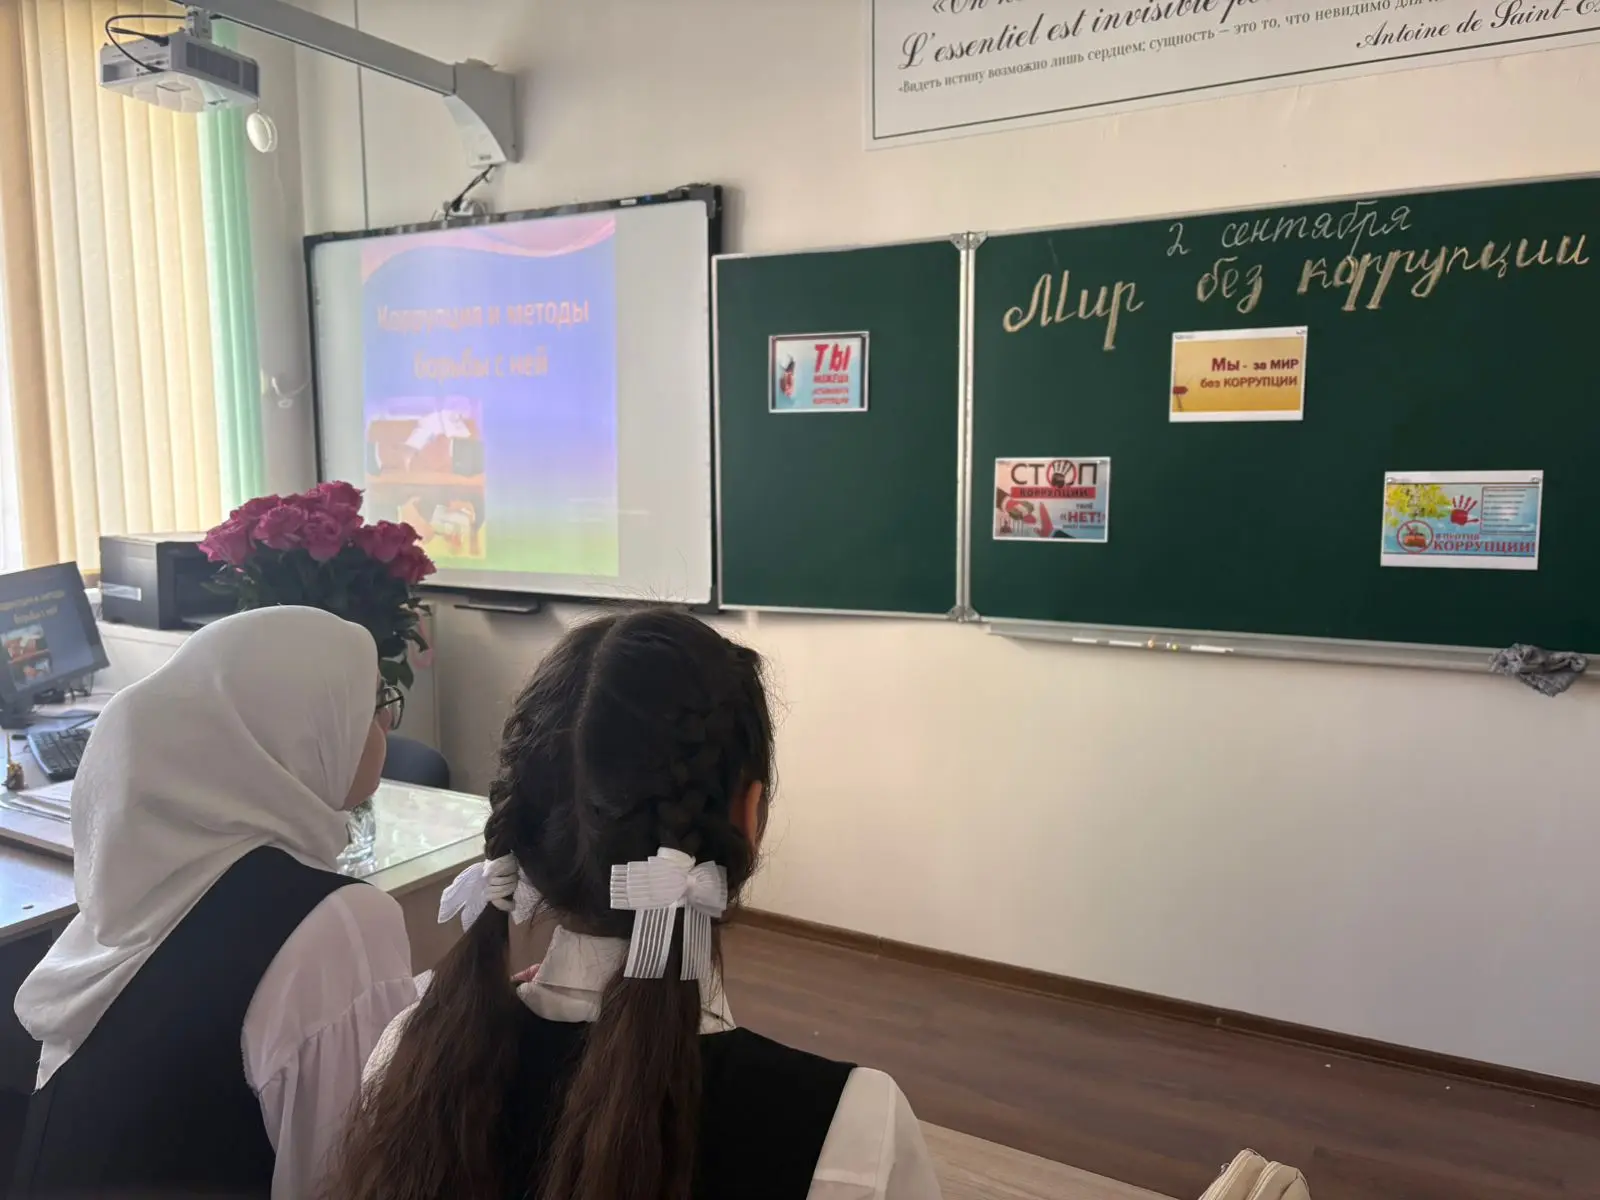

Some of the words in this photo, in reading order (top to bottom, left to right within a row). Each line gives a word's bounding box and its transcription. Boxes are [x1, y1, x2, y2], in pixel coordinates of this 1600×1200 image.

[1047, 9, 1087, 42] est
[1356, 20, 1450, 48] Antoine
[1456, 9, 1483, 33] de
[944, 71, 985, 84] истину
[988, 59, 1048, 79] возможно
[1050, 52, 1085, 68] лишь
[1087, 41, 1146, 62] сердцем;
[1149, 28, 1216, 52] сущность
[1233, 21, 1257, 34] это
[1261, 17, 1281, 30] то,
[1285, 12, 1310, 25] что
[1315, 0, 1391, 21] невидимо
[1167, 222, 1192, 256] 2
[1222, 200, 1412, 256] сентября
[1003, 270, 1144, 350] Мир
[1197, 256, 1263, 314] без
[1297, 235, 1590, 312] коррупции
[507, 299, 590, 331] методы
[509, 345, 549, 377] ней
[814, 343, 852, 373] ТЫ
[1212, 357, 1240, 371] Мы
[1253, 361, 1267, 370] за
[1270, 358, 1300, 370] МИР
[1200, 378, 1221, 388] без
[1223, 375, 1298, 388] КОРРУПЦИИ
[1011, 460, 1097, 488] СТОП
